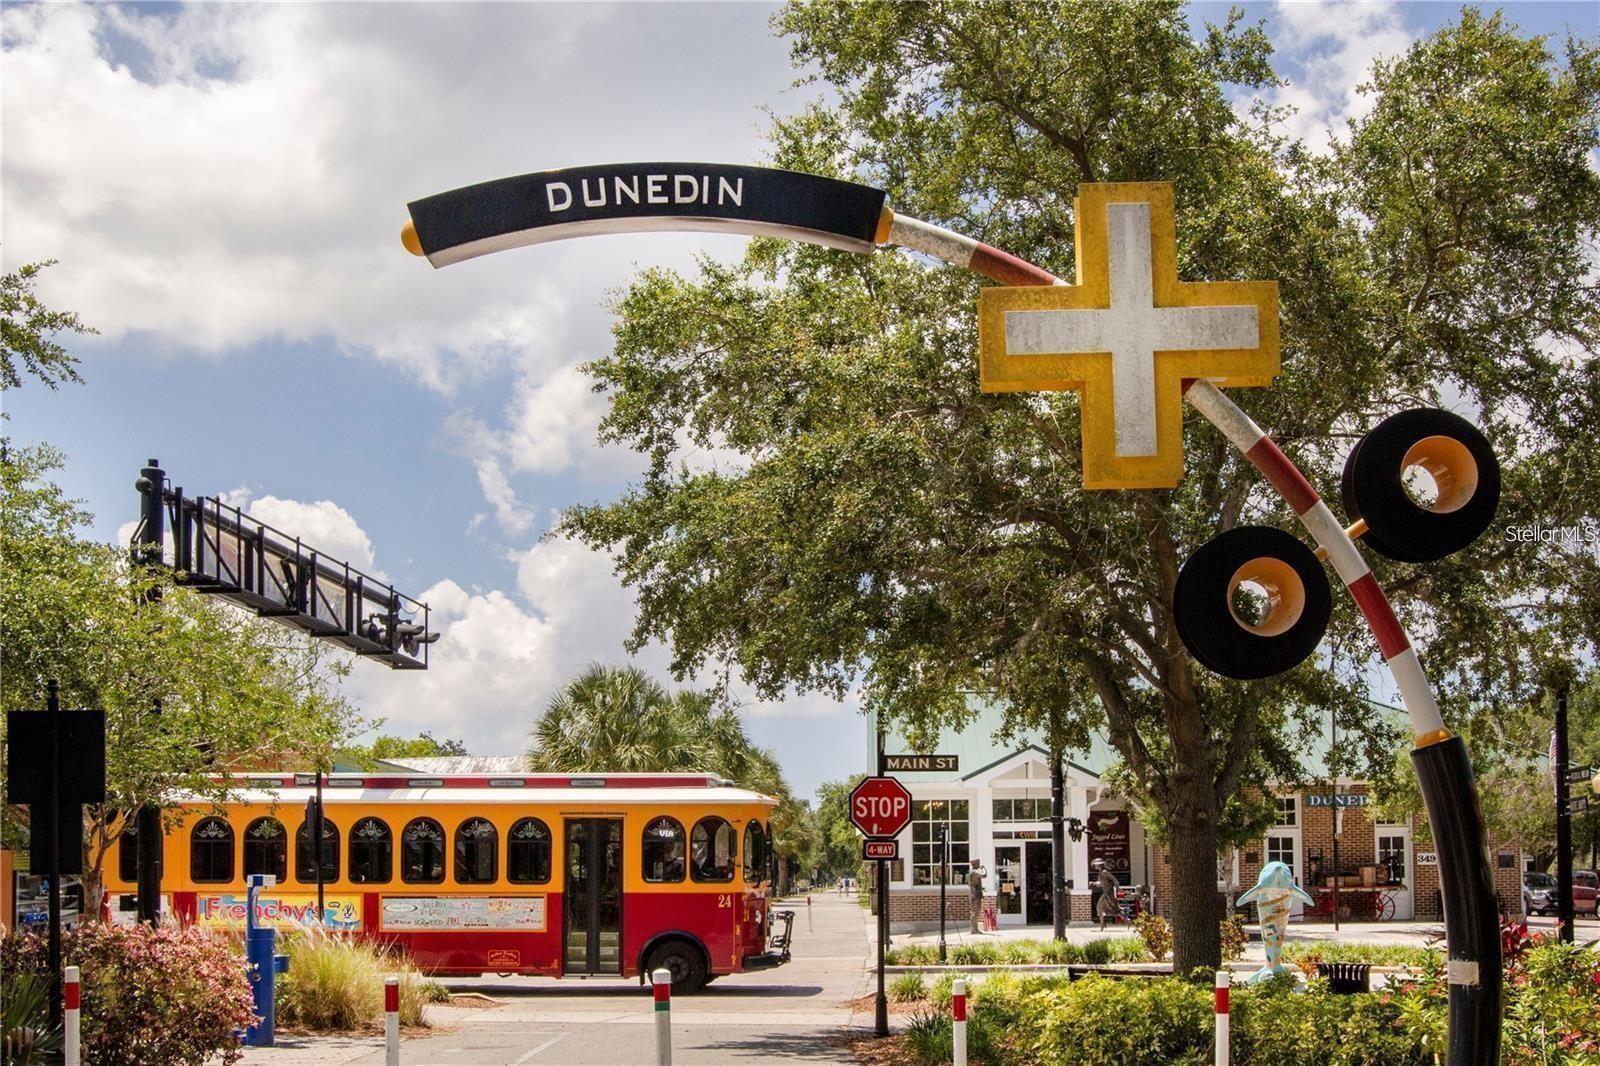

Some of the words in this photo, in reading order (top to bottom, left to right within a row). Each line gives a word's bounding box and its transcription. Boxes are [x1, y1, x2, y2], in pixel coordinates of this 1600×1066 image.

[545, 174, 743, 212] DUNEDIN
[887, 758, 930, 769] MAIN
[936, 757, 956, 769] ST
[855, 796, 906, 818] STOP
[868, 846, 893, 855] 4-WAY
[1417, 854, 1437, 863] 349
[718, 894, 732, 908] 24
